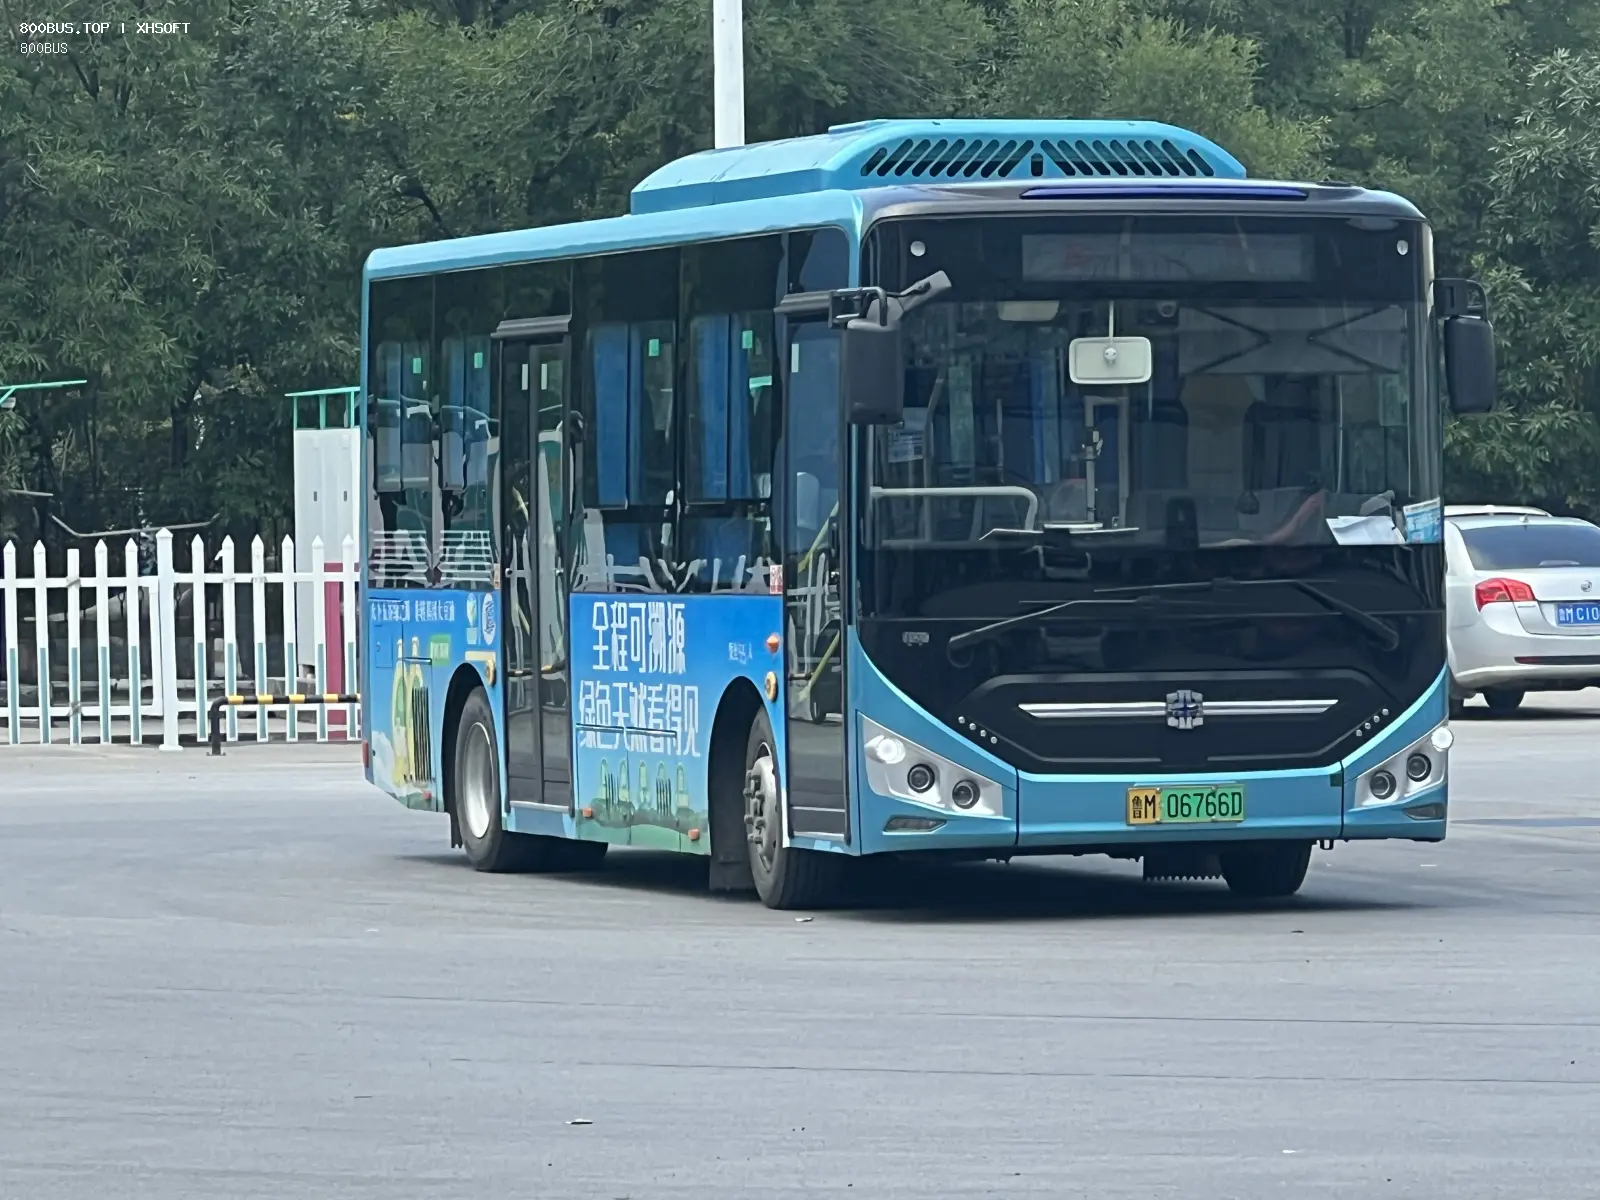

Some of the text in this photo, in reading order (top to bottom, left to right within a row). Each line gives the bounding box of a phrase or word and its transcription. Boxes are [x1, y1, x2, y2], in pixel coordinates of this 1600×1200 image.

[592, 601, 686, 674] 全程可溯源
